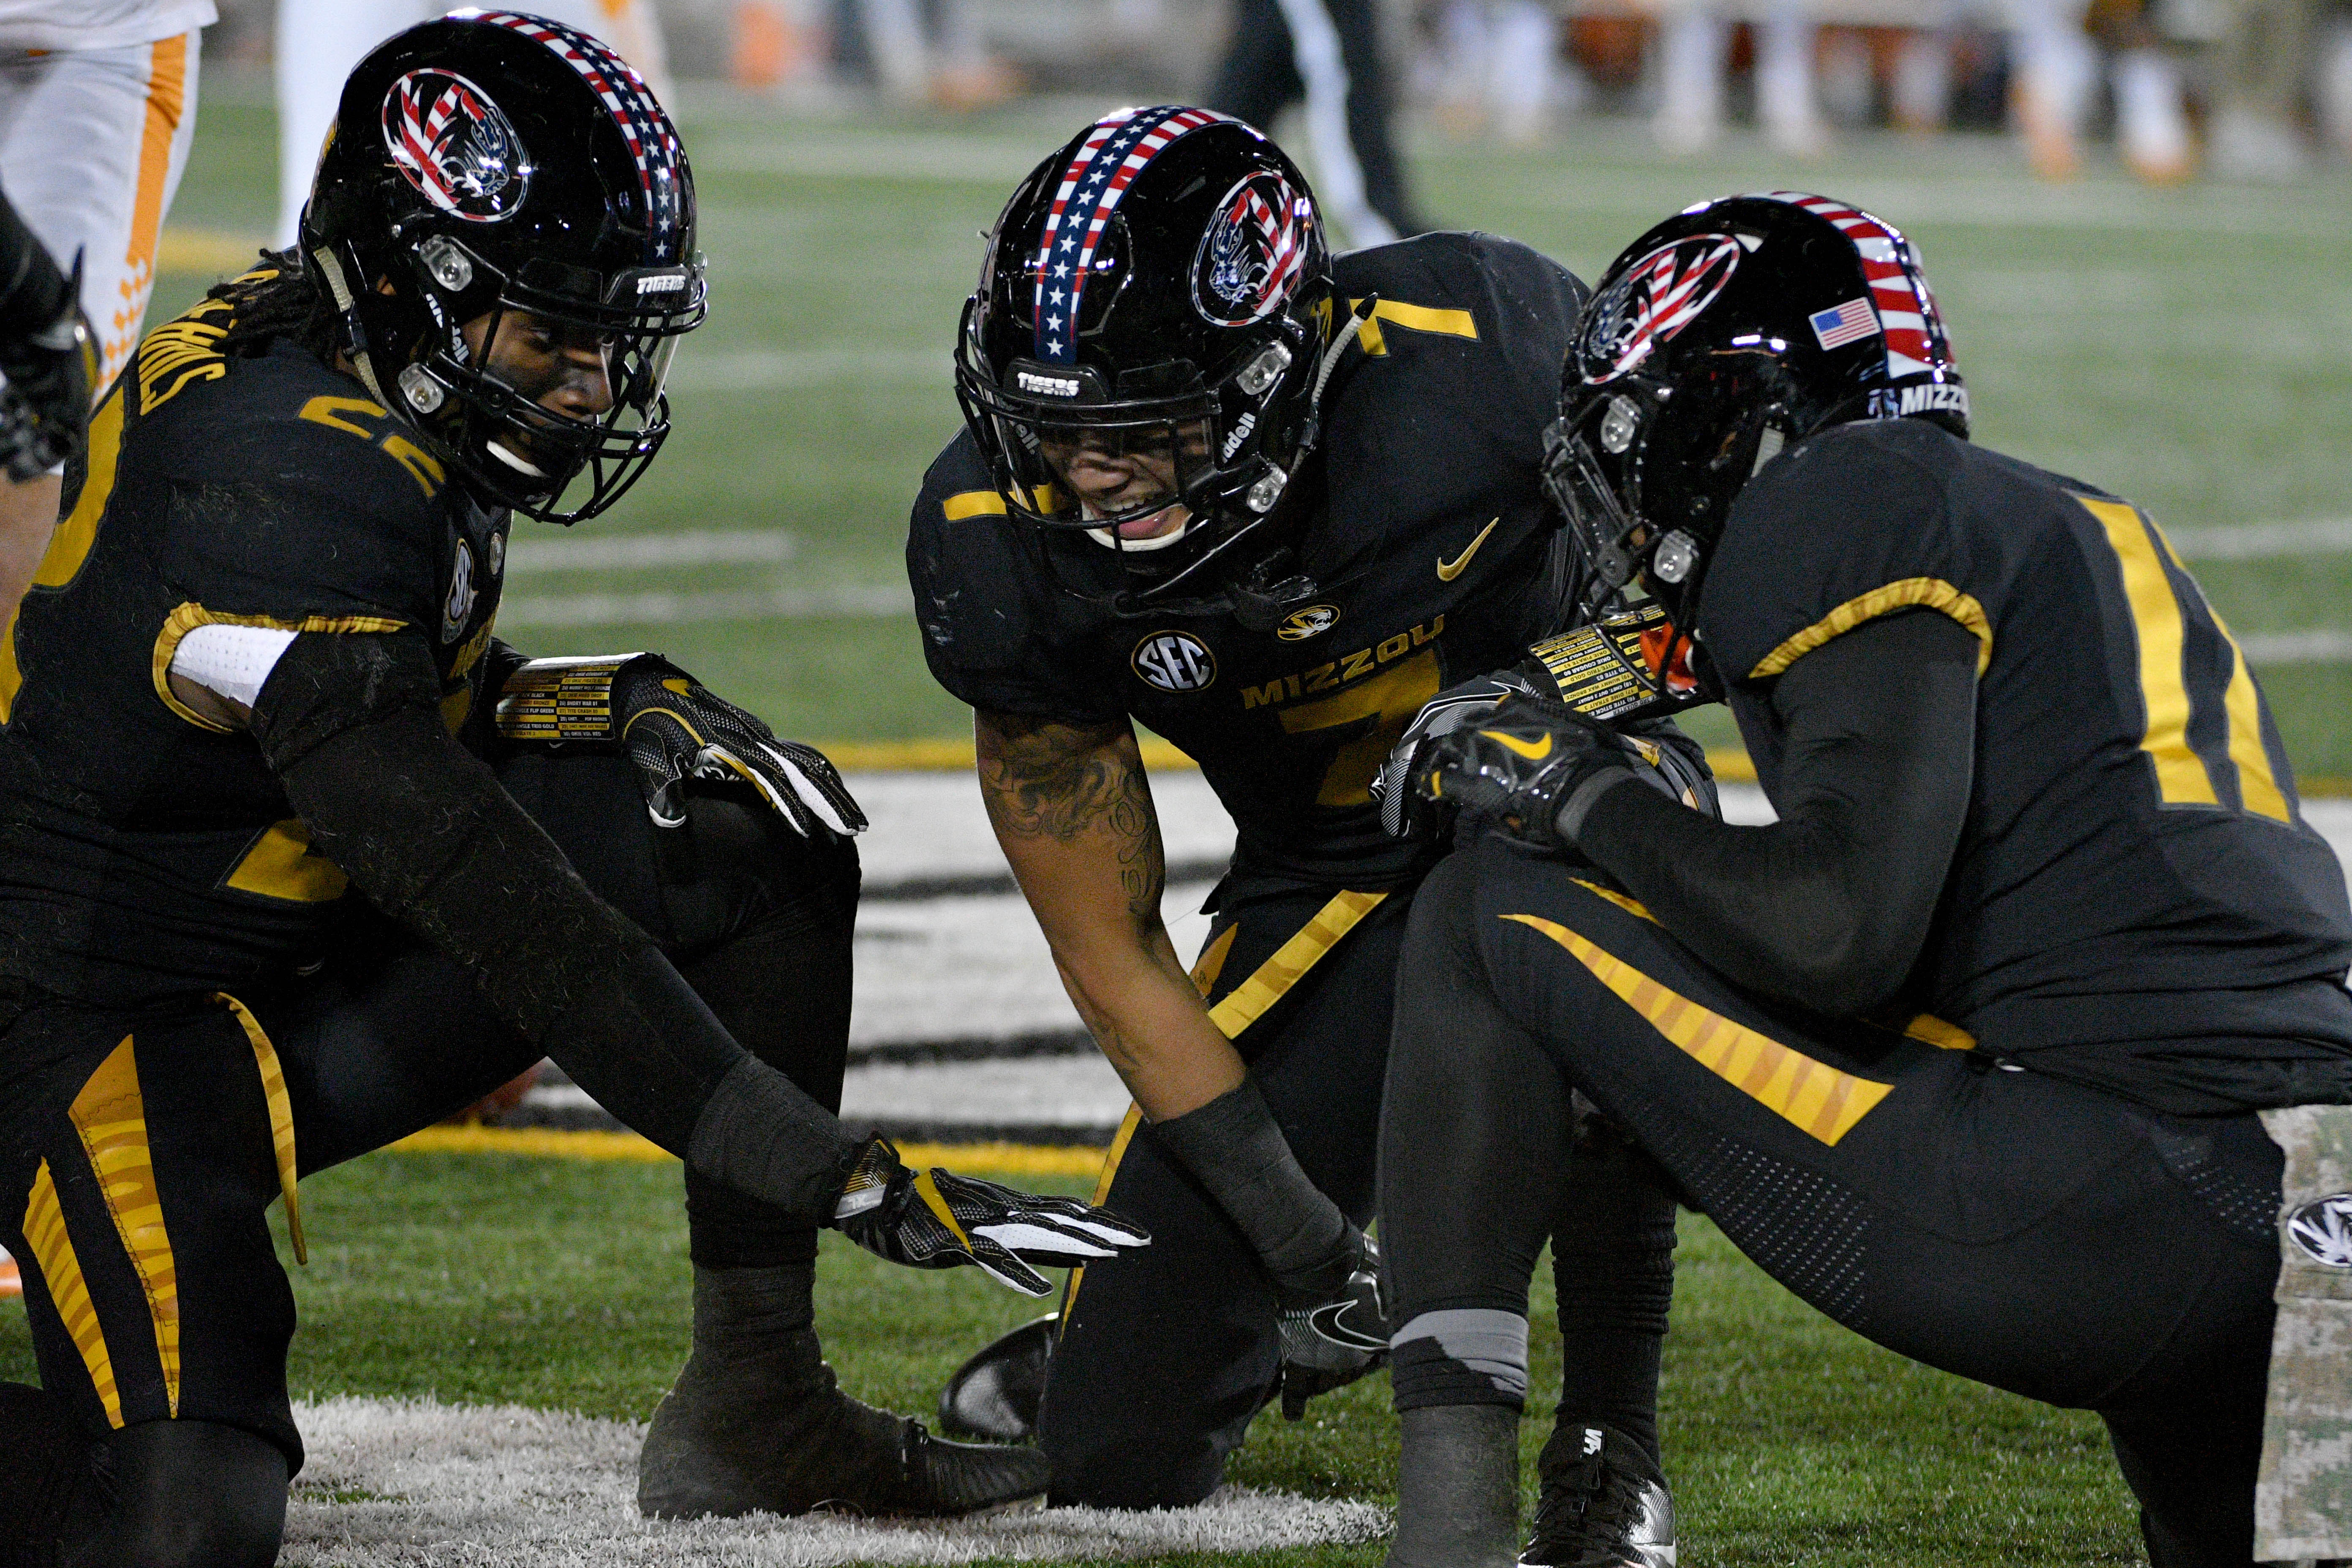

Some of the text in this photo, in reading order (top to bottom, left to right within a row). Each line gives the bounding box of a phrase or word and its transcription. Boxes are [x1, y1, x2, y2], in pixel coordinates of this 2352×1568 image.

[637, 274, 686, 294] TIGERS
[1018, 372, 1079, 396] TIGERS
[1568, 645, 1584, 653] HARD
[1583, 644, 1604, 654] MUMMY
[1592, 650, 1607, 658] OKIE
[1568, 651, 1584, 660] WOLF
[1571, 655, 1592, 665] PIRATE
[1596, 655, 1612, 664] OKIE
[1138, 636, 1210, 690] SEC
[1240, 614, 1445, 710] MIZZOU
[1601, 662, 1614, 670] TITE
[1571, 661, 1596, 674] COUGAR
[1587, 667, 1601, 675] TRIO
[1570, 672, 1586, 682] GOLD
[1603, 669, 1618, 678] TITE
[1600, 677, 1620, 688] MUMMY
[1565, 689, 1587, 700] BRONZE
[1576, 695, 1594, 705] SQUAT
[1589, 697, 1609, 708] STRAIT
[1595, 704, 1613, 714] STICK
[1279, 649, 1440, 806] 7
